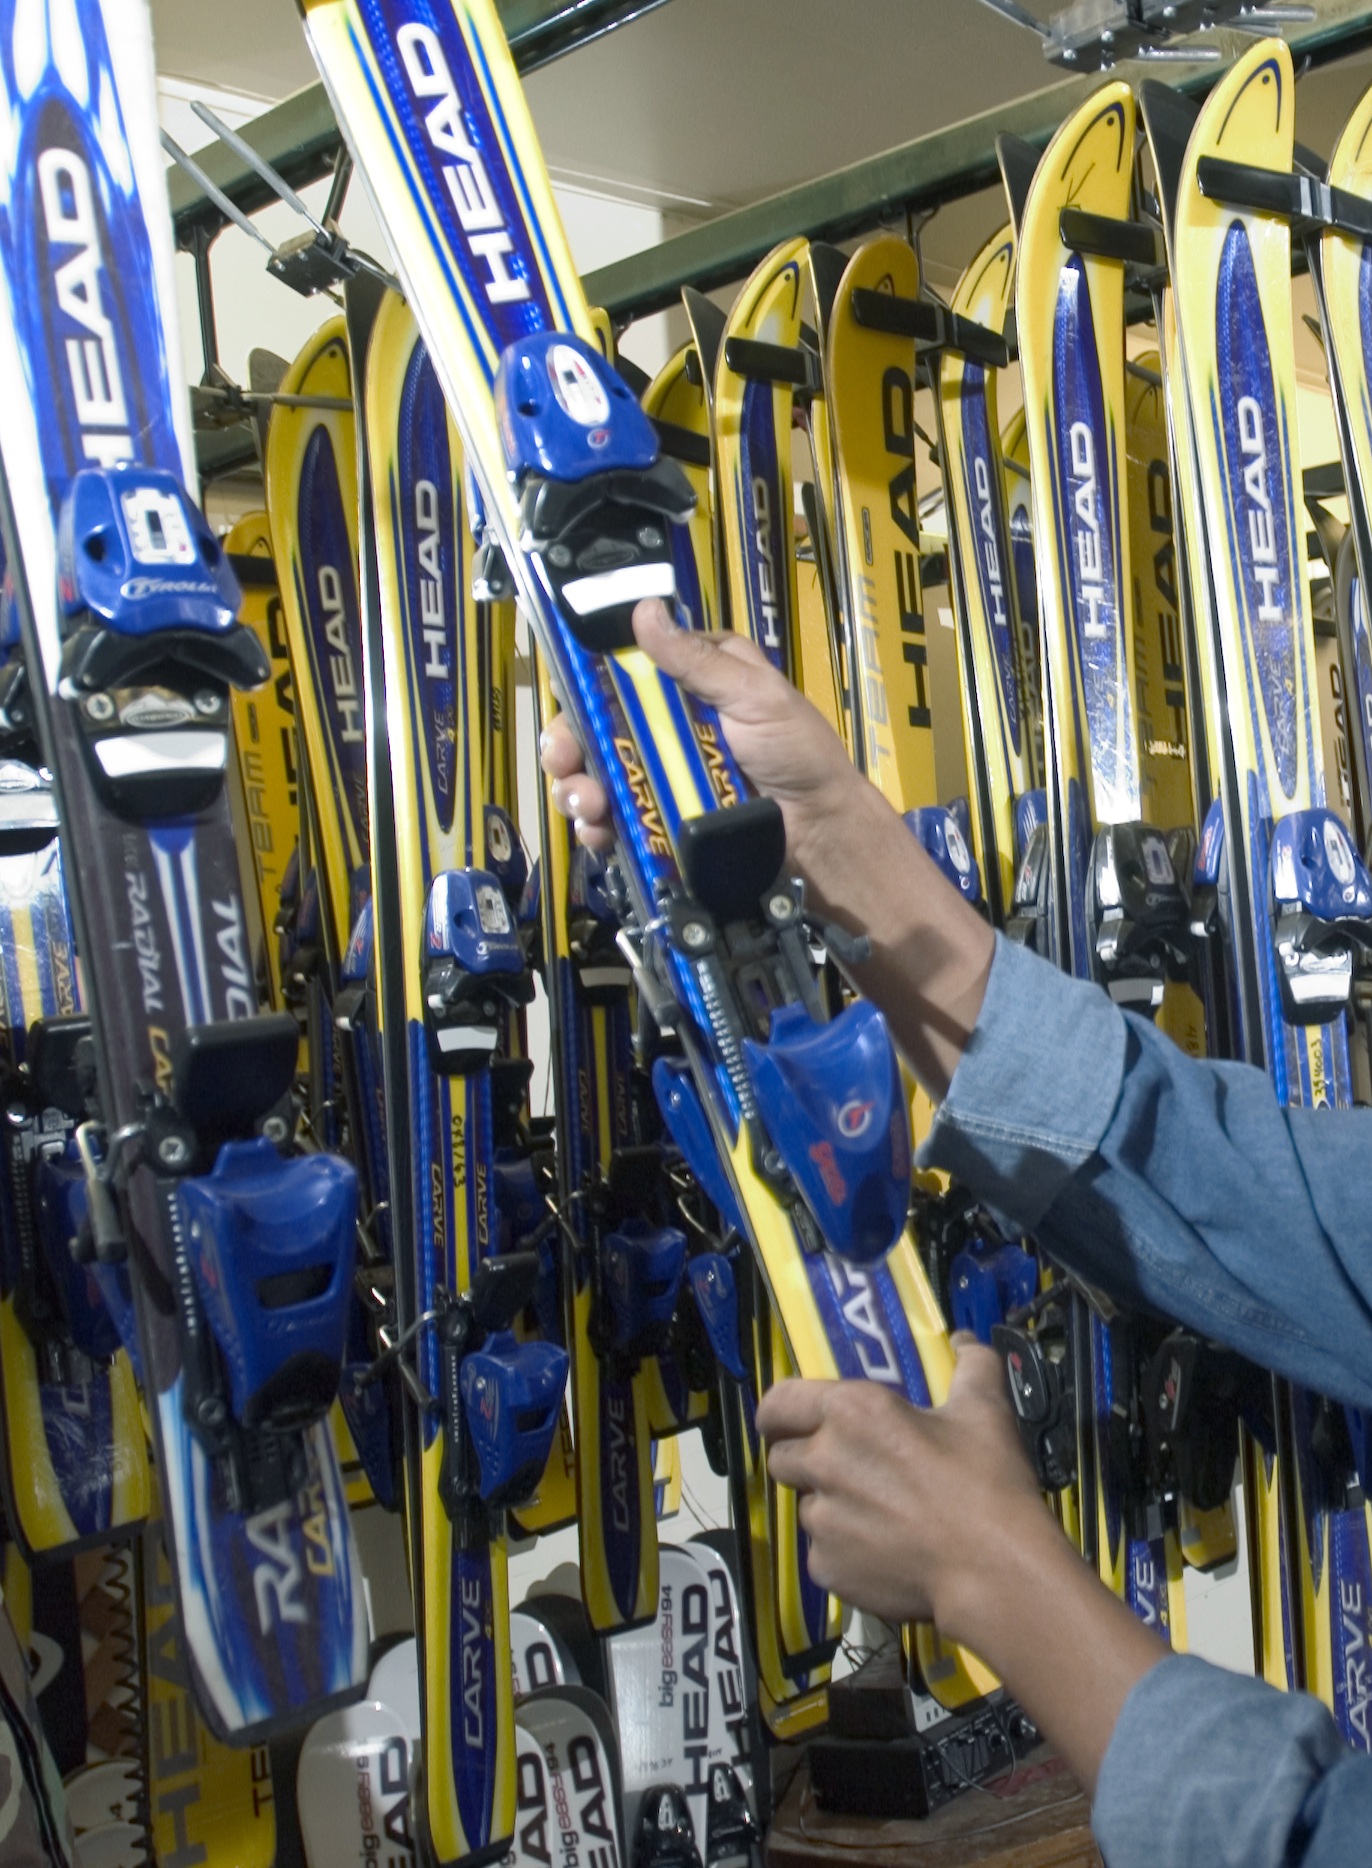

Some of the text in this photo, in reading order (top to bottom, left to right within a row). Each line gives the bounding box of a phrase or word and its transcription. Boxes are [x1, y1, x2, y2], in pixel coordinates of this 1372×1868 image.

[396, 22, 530, 304] HEAD
[414, 480, 449, 679] HEAD
[752, 476, 782, 648] HEAD
[882, 366, 931, 729] HEAD
[974, 456, 1007, 626] HEAD
[1070, 421, 1107, 638] HEAD
[1237, 395, 1283, 622] HEAD
[318, 565, 366, 744] HEAD
[435, 709, 451, 796] CARVE
[614, 737, 672, 857] CARVE
[124, 872, 165, 1014] RADIAL
[431, 1162, 447, 1247] CARVE
[475, 1162, 488, 1245] CARVE
[608, 1397, 630, 1532] CARVE
[461, 1576, 484, 1750] CARVE
[681, 1584, 710, 1796] HEAD
[707, 1568, 753, 1767] HEAD
